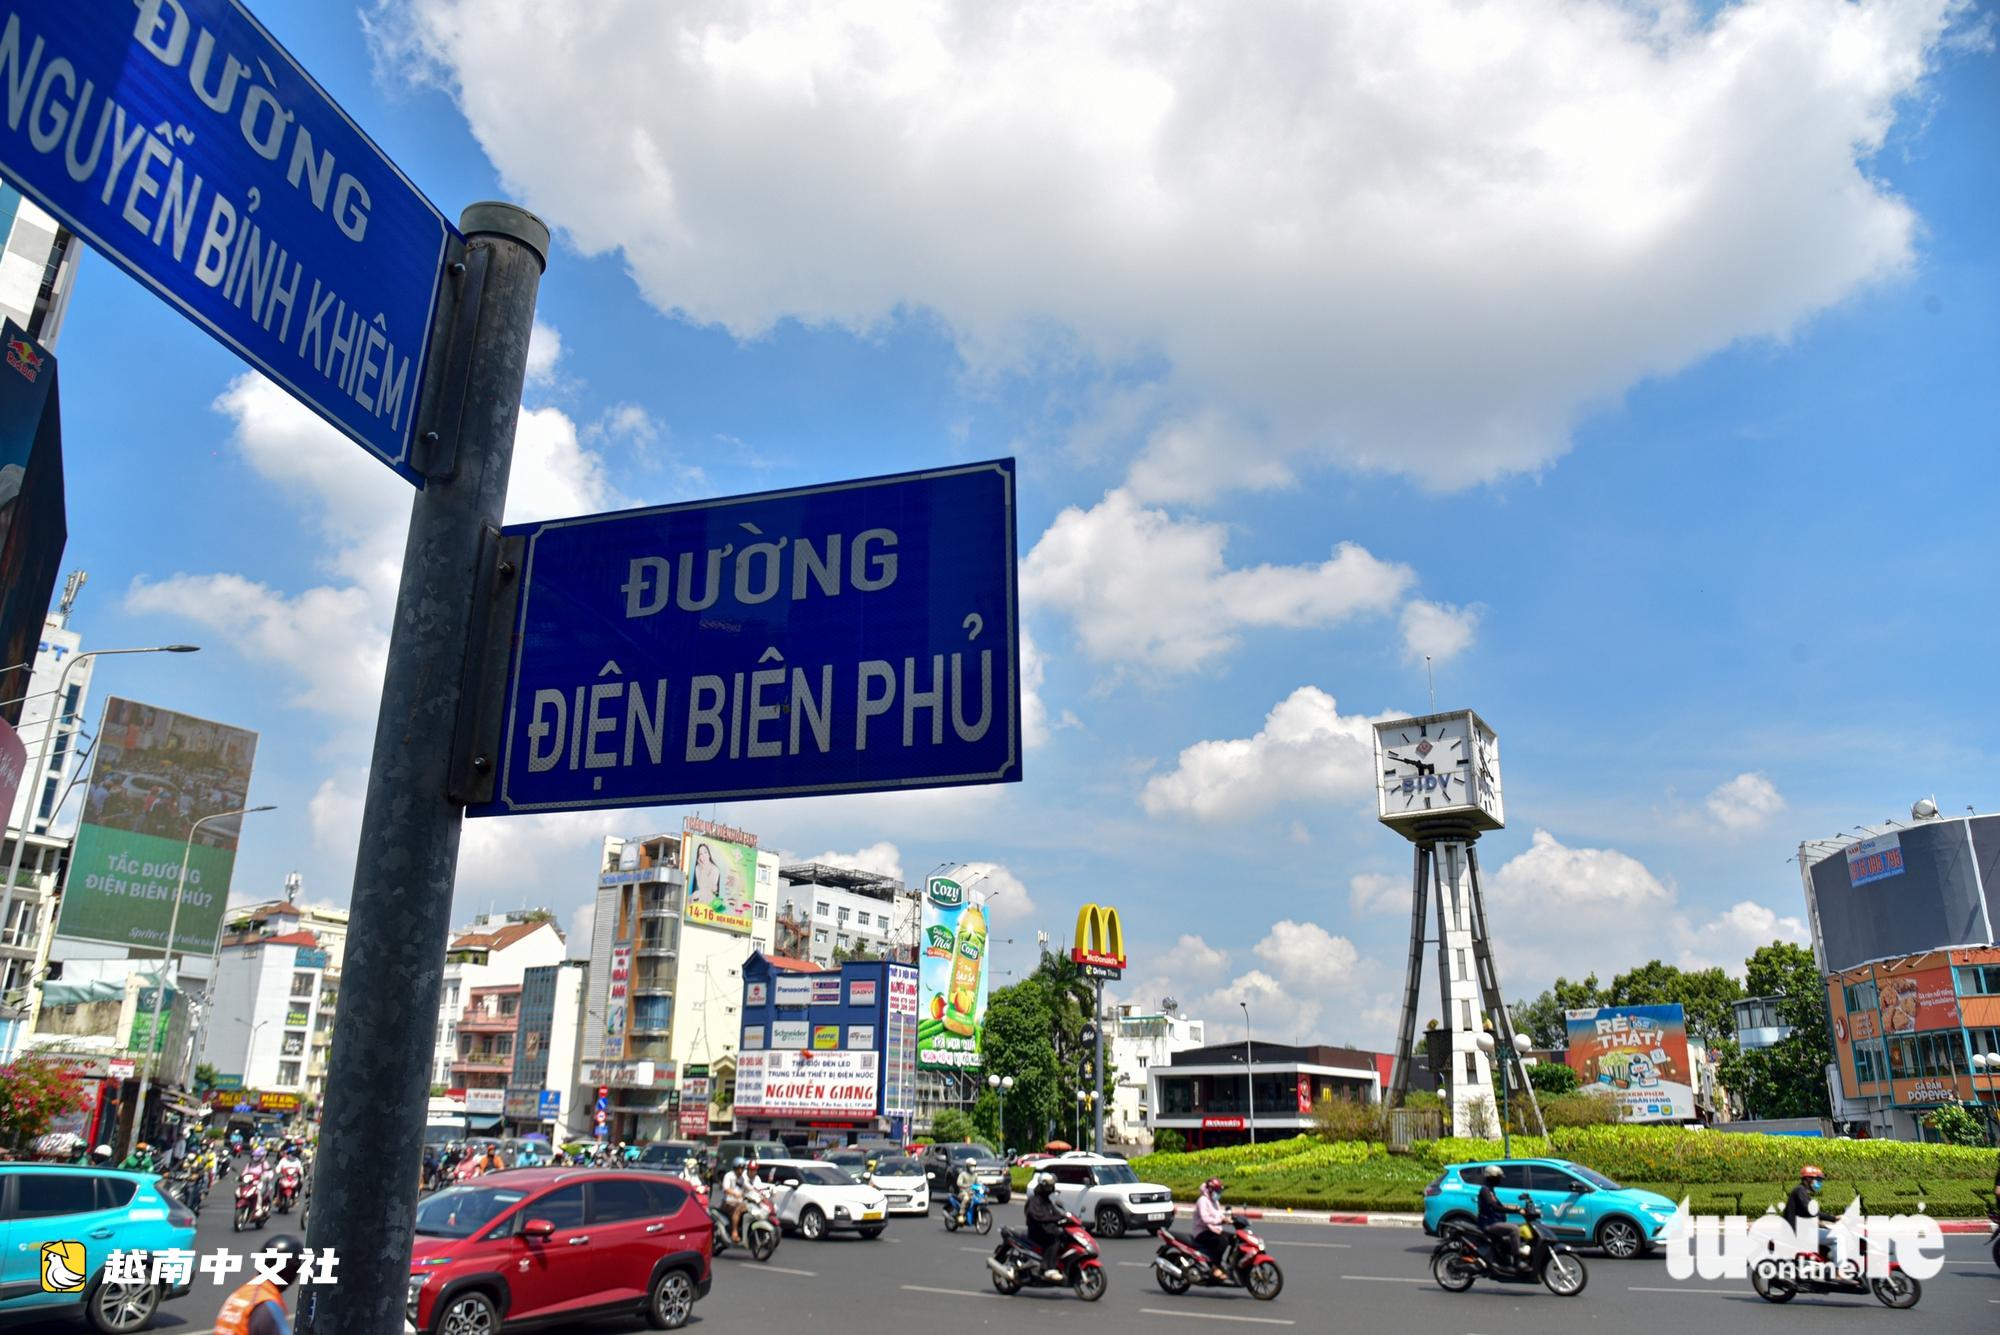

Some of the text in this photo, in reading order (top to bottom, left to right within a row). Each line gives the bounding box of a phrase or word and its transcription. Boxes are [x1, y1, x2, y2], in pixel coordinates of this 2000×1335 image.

[132, 0, 373, 243] ĐƯỜNG
[0, 13, 410, 432] NGUYỄN BỈNH KHIÊM
[621, 522, 899, 619] ĐƯỜNG
[527, 612, 993, 791] ĐIỆN BIÊN PHỦ
[1402, 773, 1451, 794] BIDV
[84, 873, 127, 896] ĐIỆN
[128, 881, 168, 901] BIÊN
[932, 881, 960, 902] Cozy
[689, 905, 714, 920] 14-16
[961, 943, 978, 959] Cozy
[1087, 954, 1118, 965] McDonald's
[1093, 966, 1107, 976] Drive
[1595, 1013, 1628, 1035] RẺ
[774, 1029, 807, 1042] Schneider
[829, 1085, 873, 1100] GIANG
